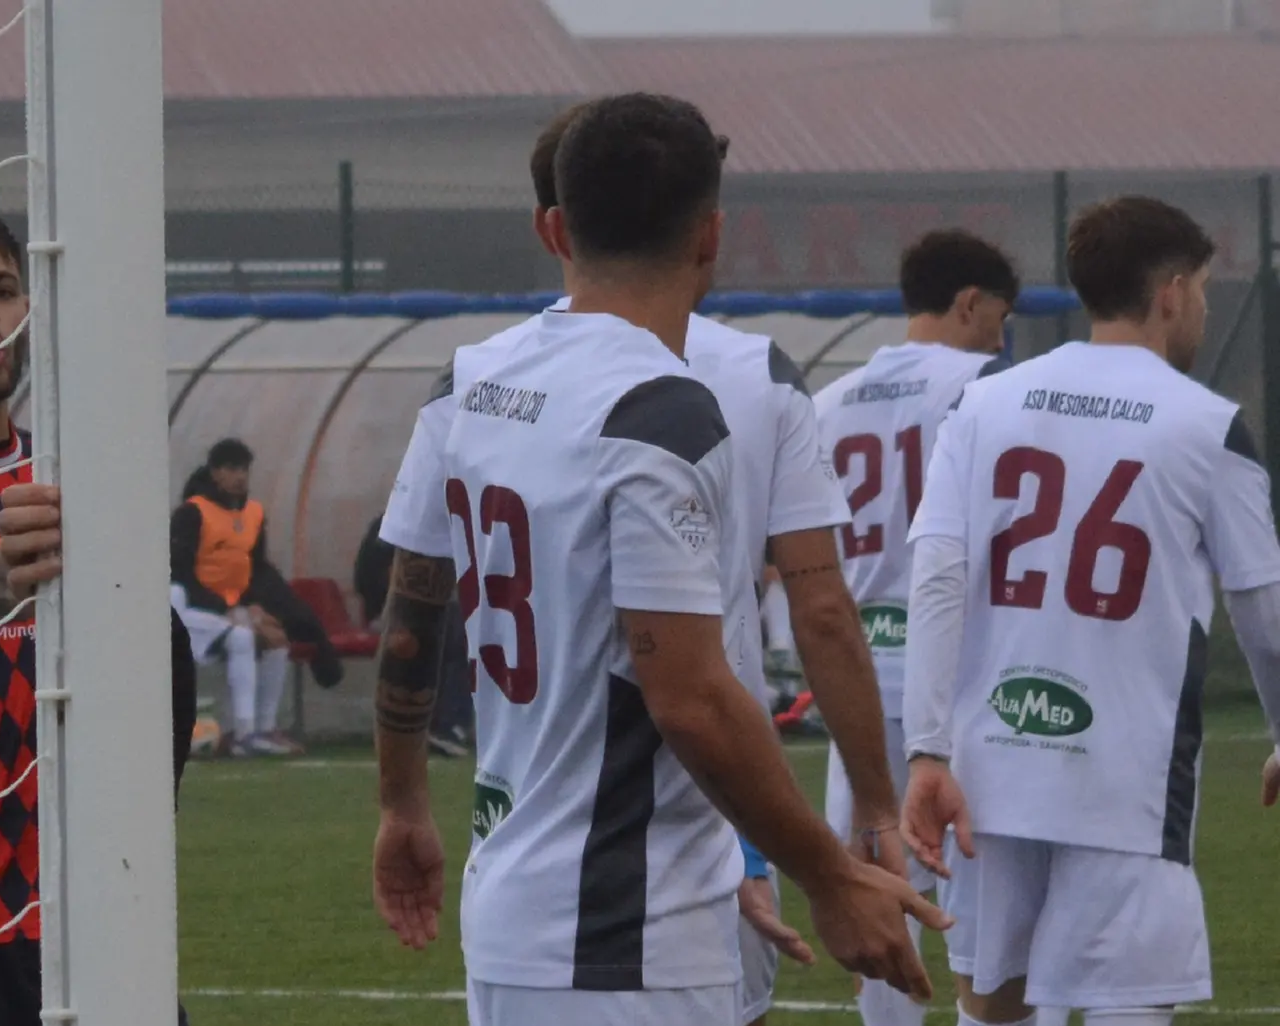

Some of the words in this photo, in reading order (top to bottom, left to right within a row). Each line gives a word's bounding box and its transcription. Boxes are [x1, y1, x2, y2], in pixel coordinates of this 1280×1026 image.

[1022, 389, 1047, 410] ASD
[1046, 391, 1111, 419] MESORACA
[1110, 398, 1154, 424] CALCIO
[833, 424, 924, 560] 21
[990, 446, 1151, 621] 26
[445, 478, 539, 704] 23
